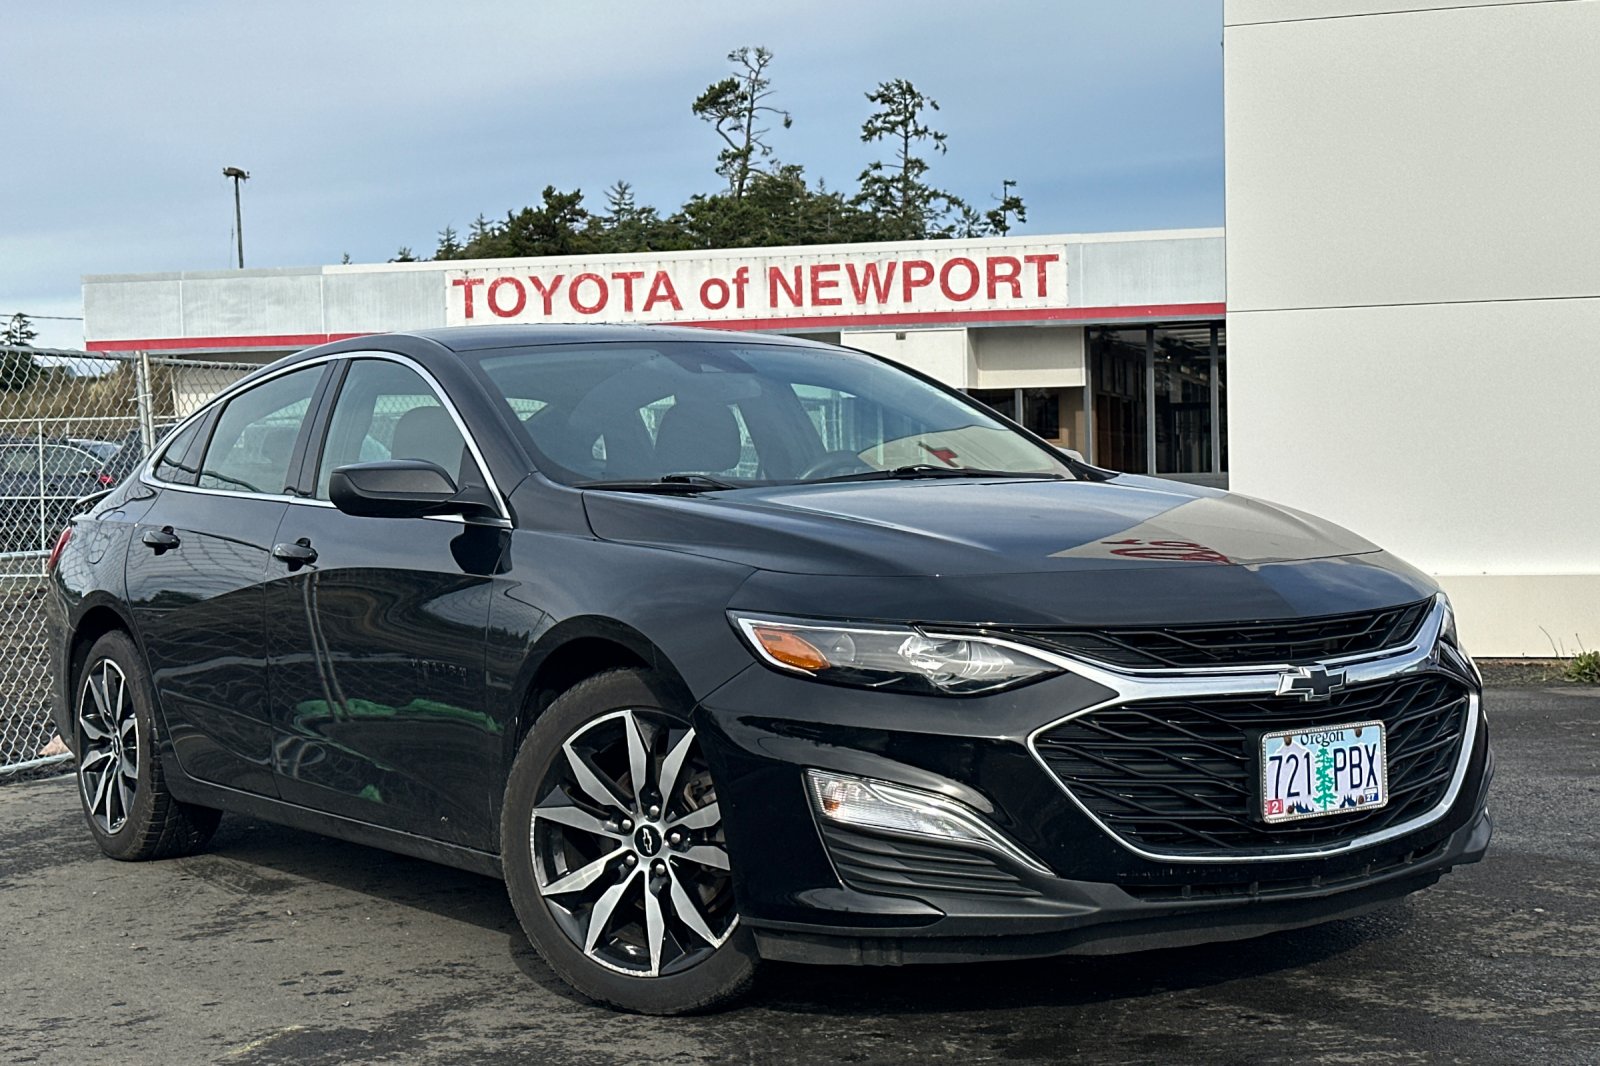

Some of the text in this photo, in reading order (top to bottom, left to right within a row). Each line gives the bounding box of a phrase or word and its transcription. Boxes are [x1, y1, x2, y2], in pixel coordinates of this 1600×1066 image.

[453, 254, 1060, 319] TOYOTA of NEWPORT
[1300, 730, 1345, 747] Oregon
[1269, 744, 1378, 799] 721 PBX
[1271, 800, 1280, 814] 2
